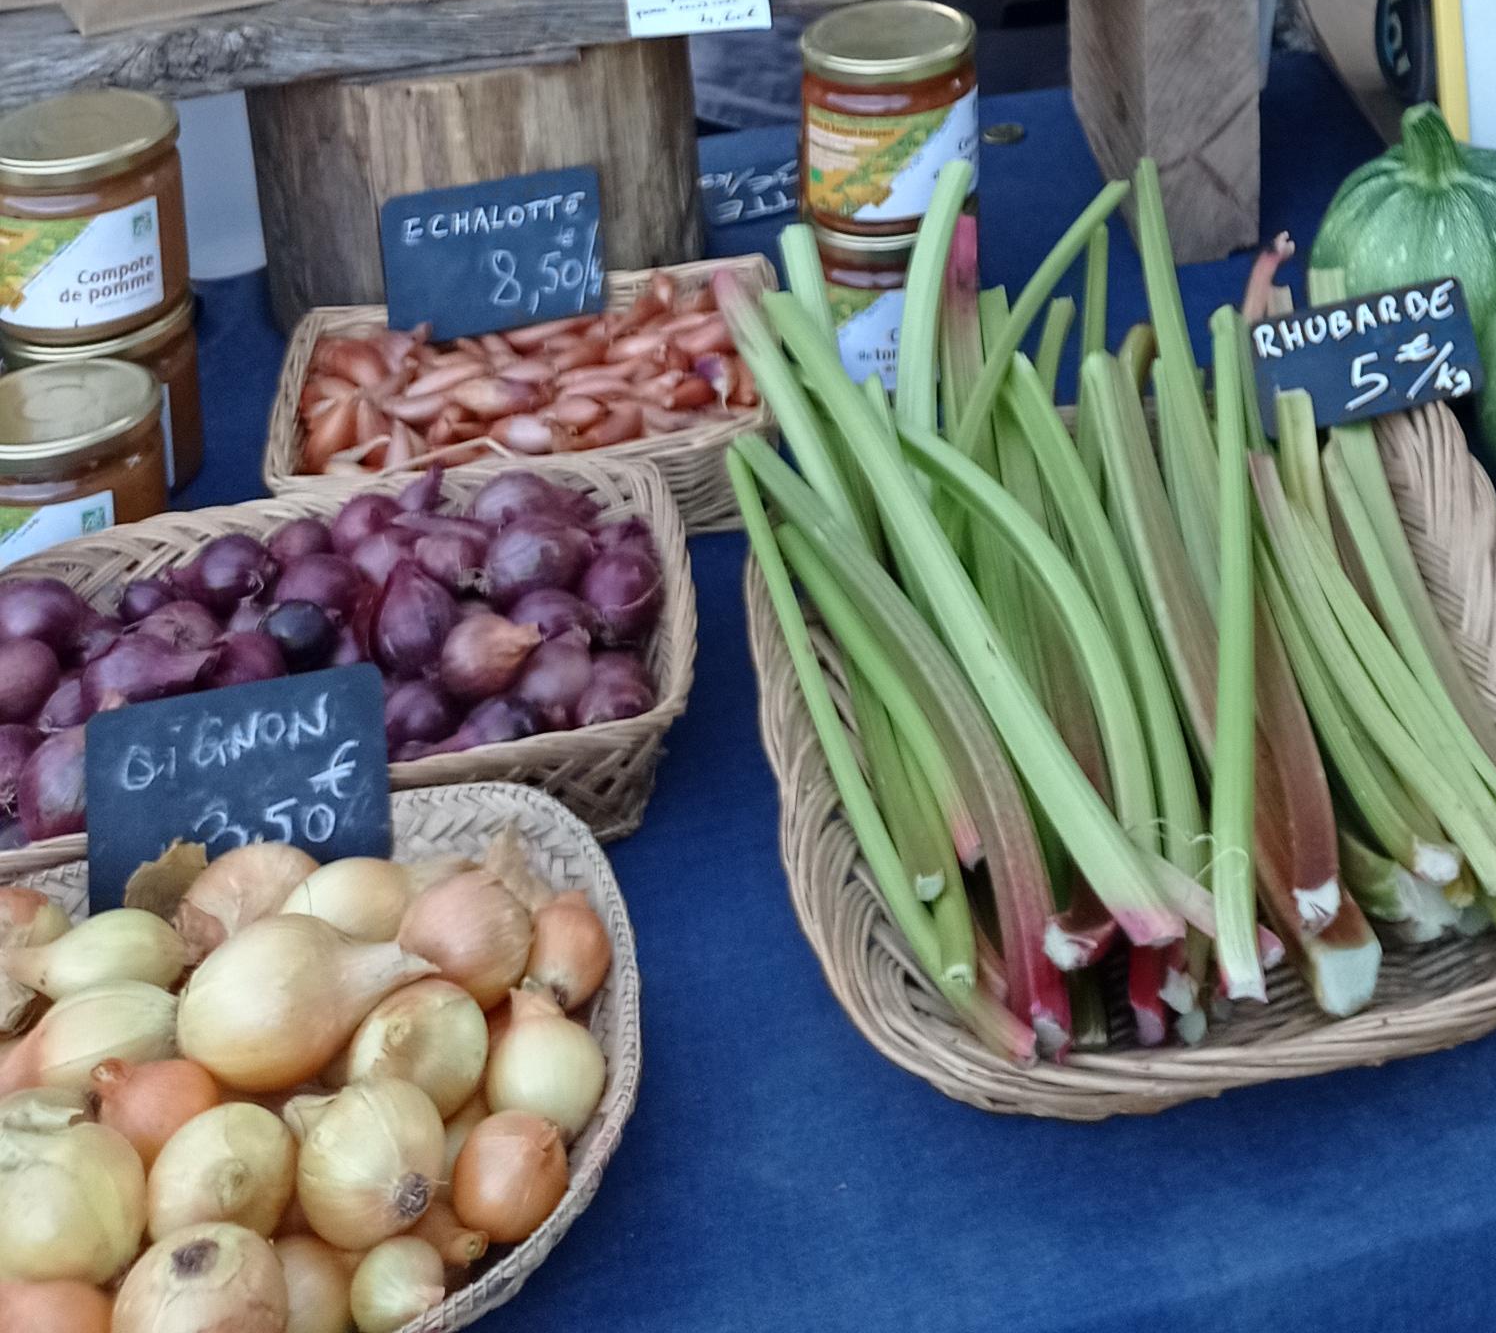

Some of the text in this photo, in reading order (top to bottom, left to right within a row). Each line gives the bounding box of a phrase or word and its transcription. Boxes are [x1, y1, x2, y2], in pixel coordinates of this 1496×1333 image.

[77, 254, 154, 285] Compote
[59, 288, 82, 304] de
[89, 270, 154, 305] pomme
